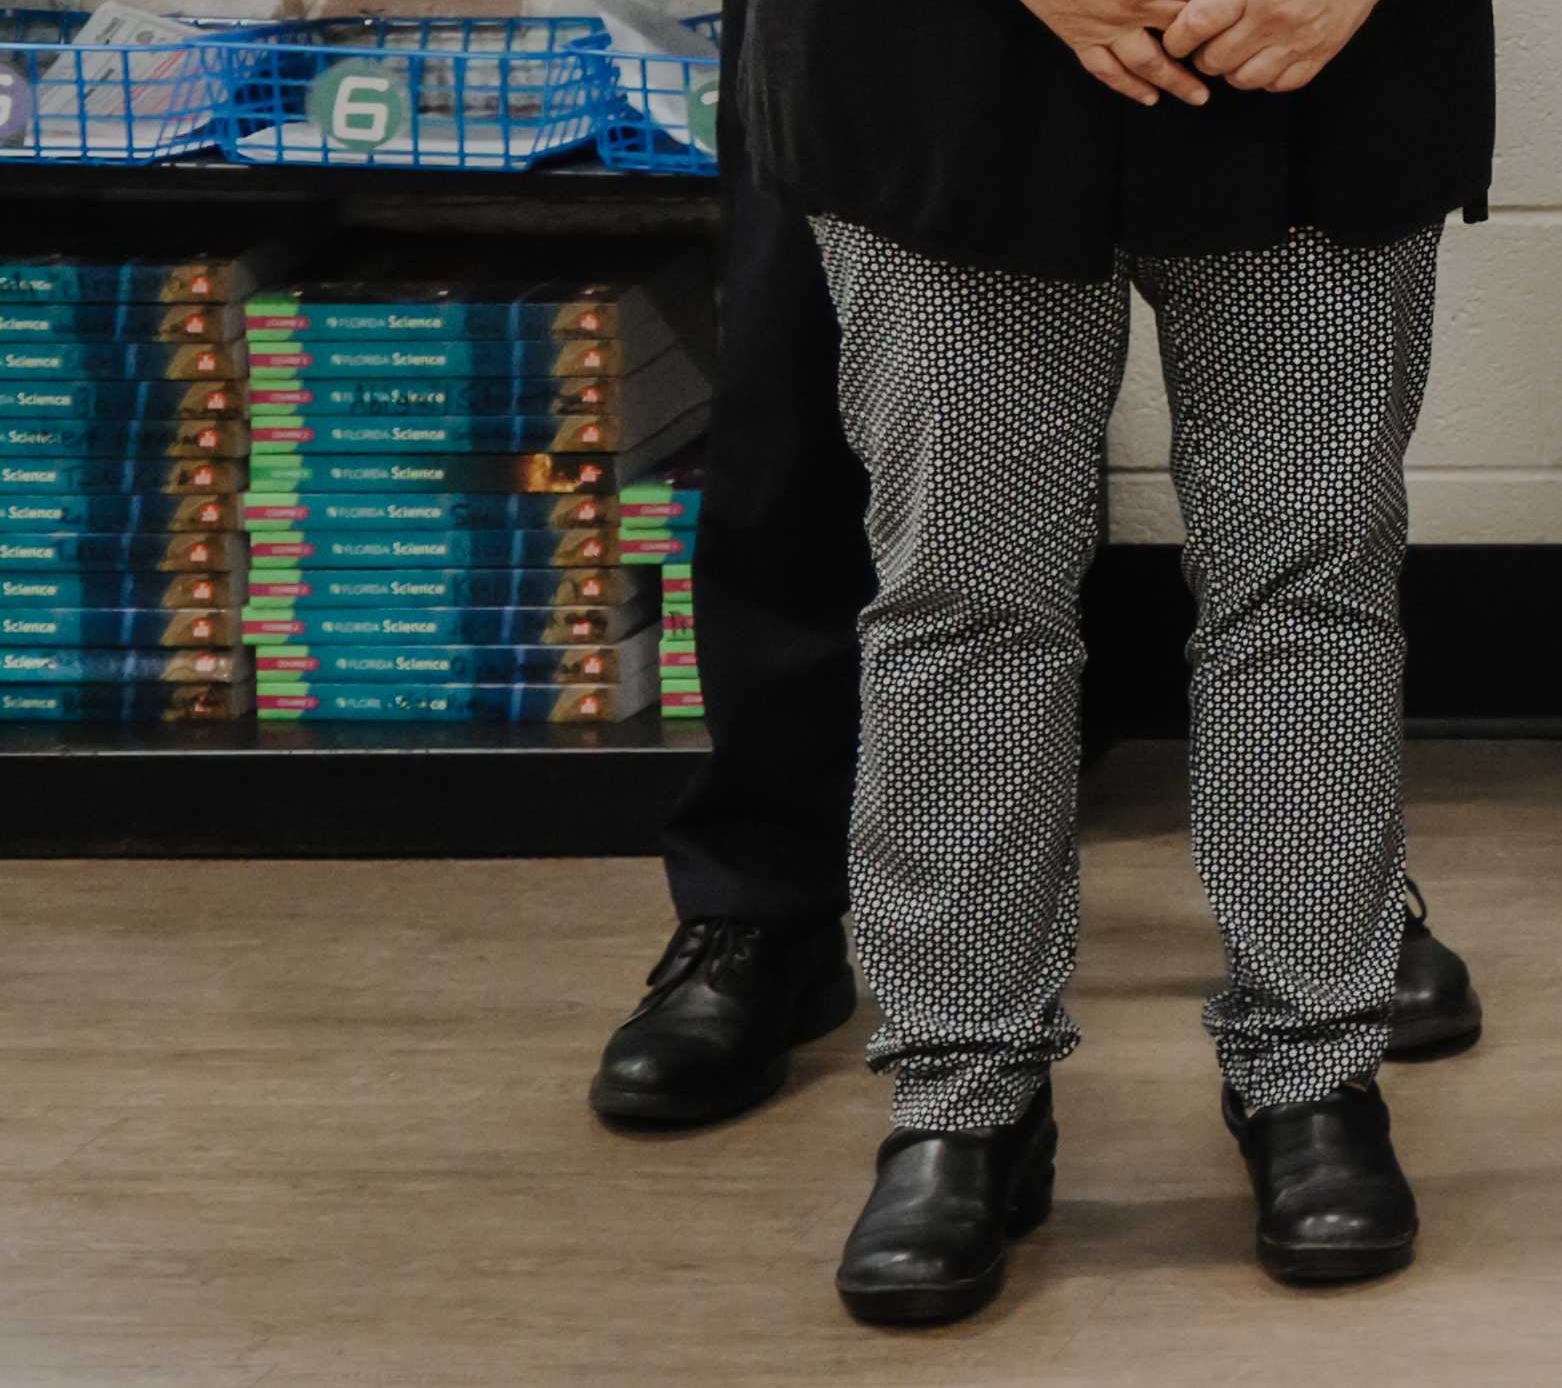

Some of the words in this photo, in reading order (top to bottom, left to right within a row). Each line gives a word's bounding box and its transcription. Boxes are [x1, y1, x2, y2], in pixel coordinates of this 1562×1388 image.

[333, 76, 388, 140] 6
[388, 315, 442, 328] Science
[6, 354, 60, 367] Science
[392, 352, 447, 365] Science
[17, 391, 71, 405] Science
[392, 427, 446, 440] Science
[3, 468, 56, 481] Science
[391, 465, 445, 480] Science
[8, 506, 62, 519] Science
[387, 504, 442, 518] Science
[393, 541, 447, 555] Science
[390, 582, 445, 595] Science
